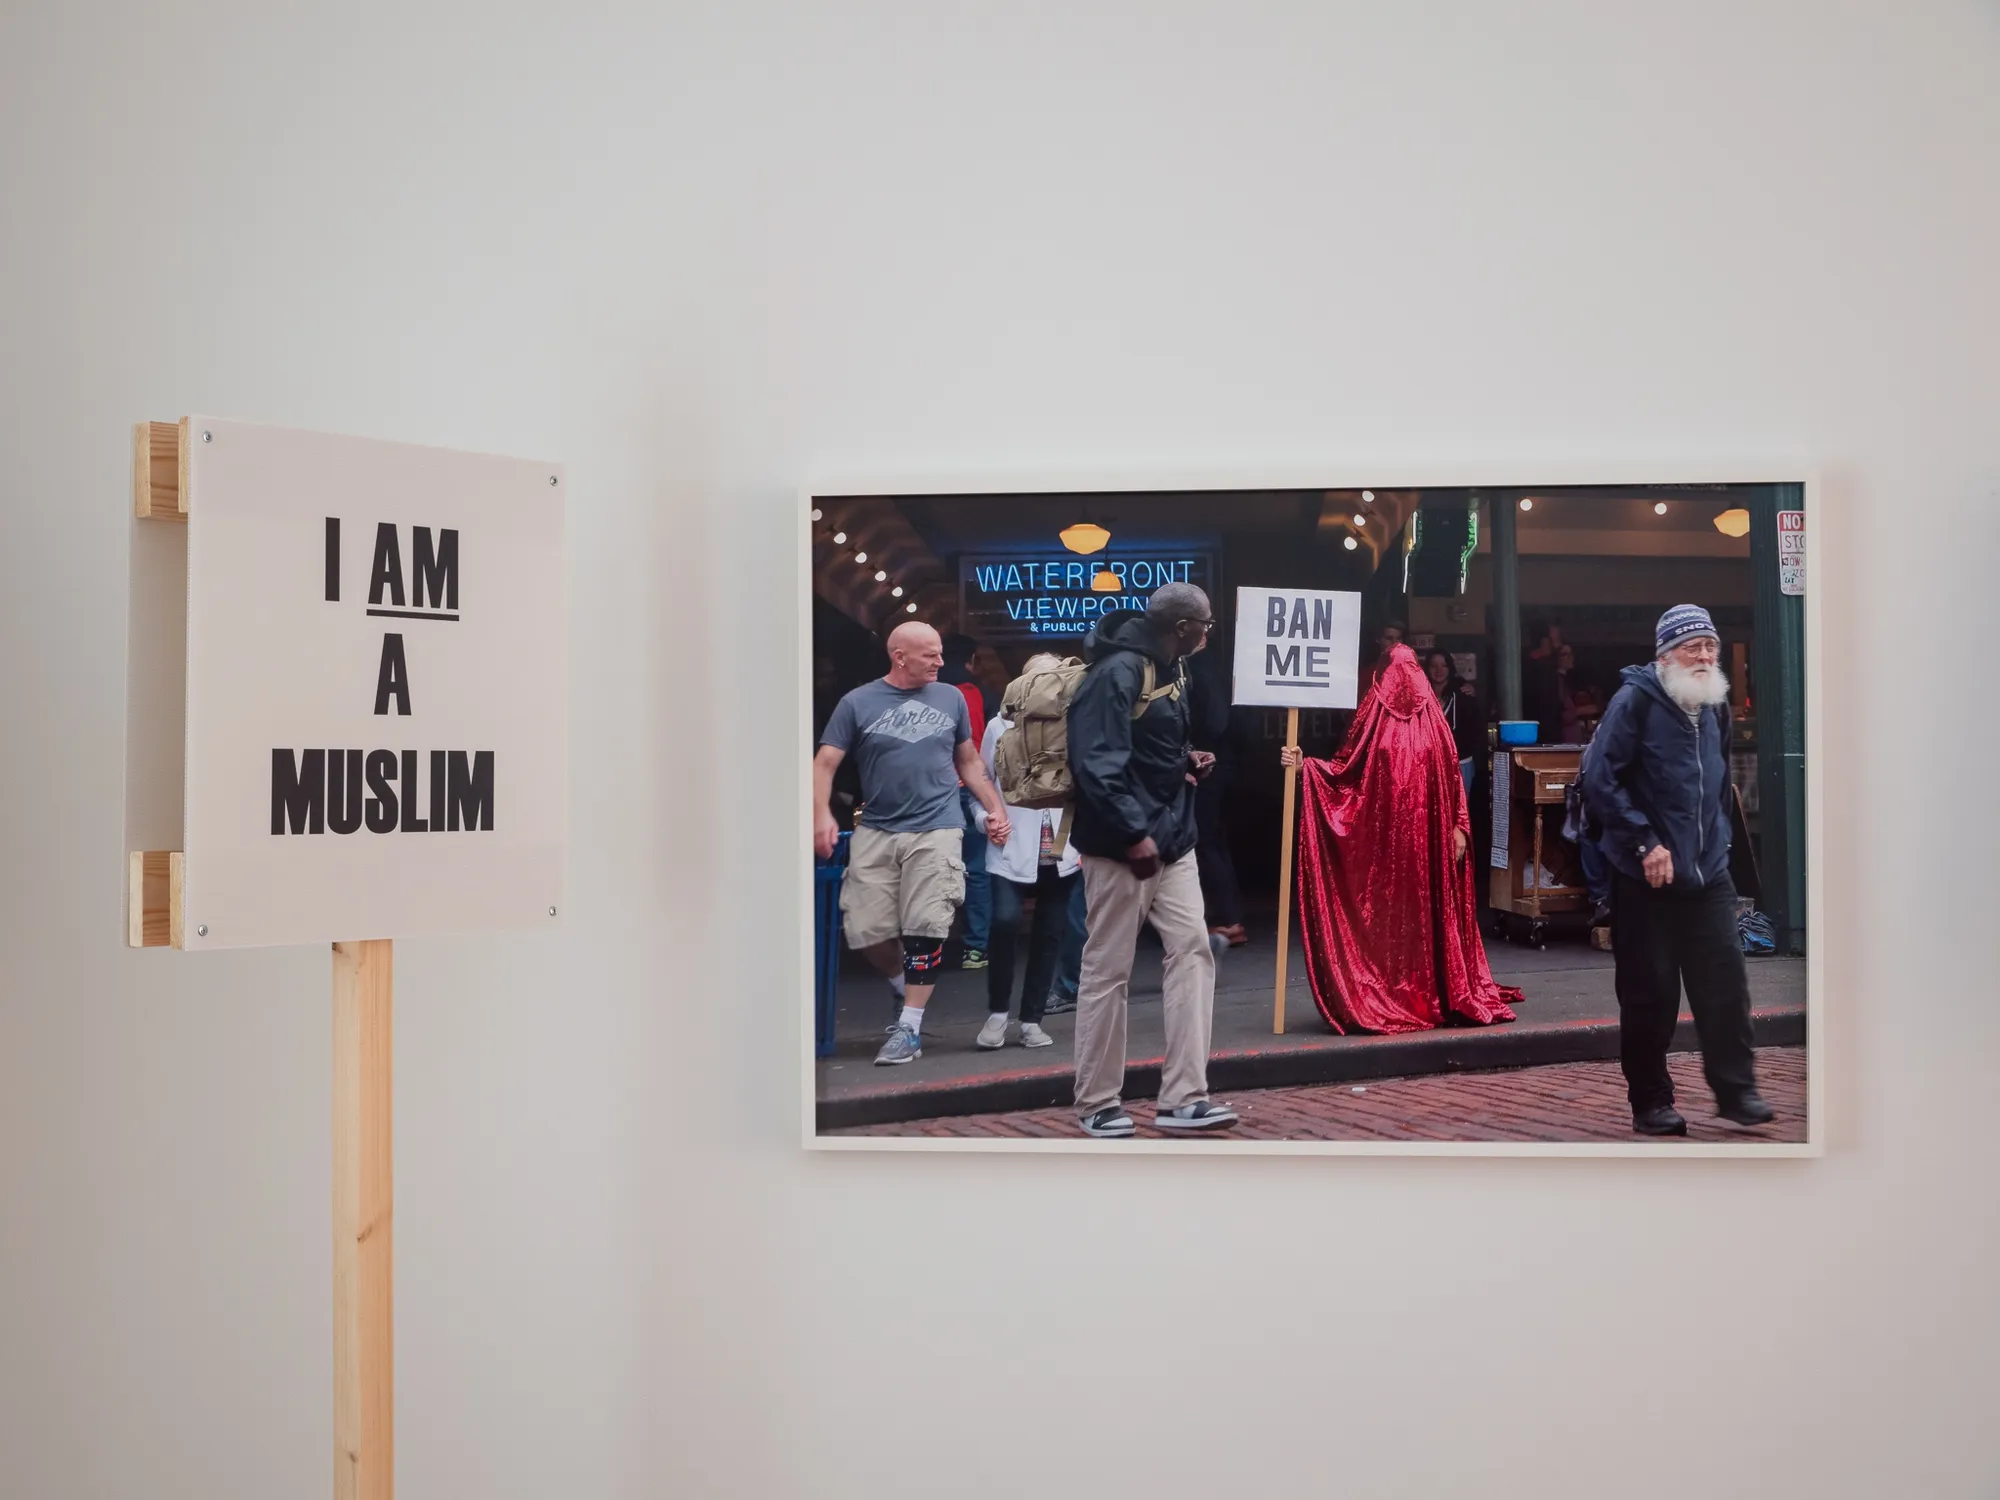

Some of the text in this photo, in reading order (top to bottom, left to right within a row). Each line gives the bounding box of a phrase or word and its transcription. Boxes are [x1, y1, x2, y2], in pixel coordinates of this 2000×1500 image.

[1782, 514, 1801, 530] NO
[325, 516, 459, 610] I AM
[975, 560, 1195, 593] WATERFRONT
[1006, 596, 1150, 620] VIEWPOIN
[1266, 596, 1333, 640] BAN
[1030, 622, 1039, 633] &
[1042, 622, 1085, 632] PUBLIC
[373, 632, 412, 716] A
[1265, 644, 1331, 678] ME
[873, 705, 951, 735] Hurley
[270, 748, 495, 836] MUSLIM
